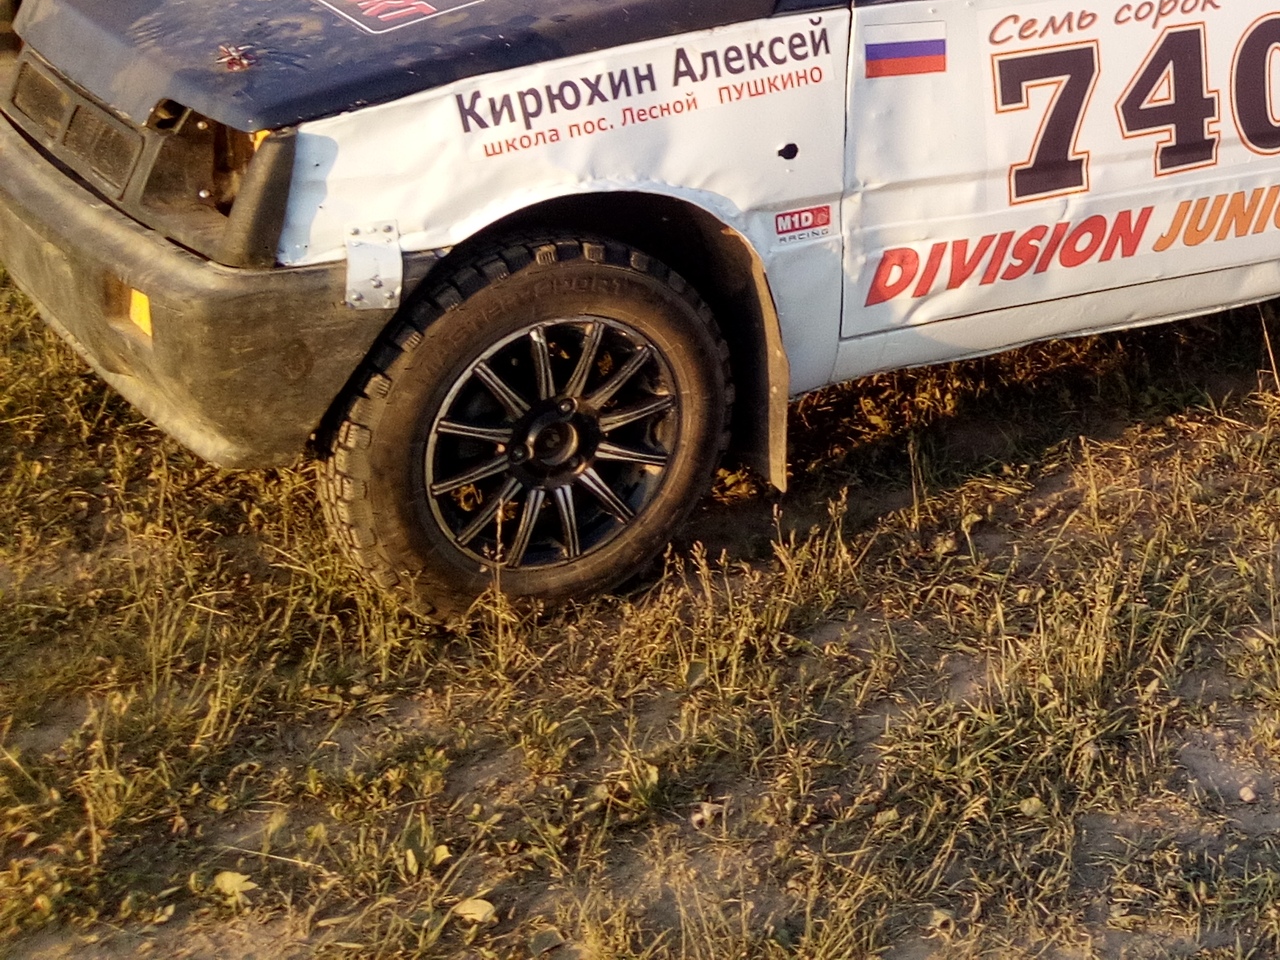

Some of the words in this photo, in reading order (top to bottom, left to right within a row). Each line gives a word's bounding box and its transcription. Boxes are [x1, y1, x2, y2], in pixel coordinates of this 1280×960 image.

[455, 62, 657, 133] Кирюхин
[672, 16, 831, 87] Алексей
[988, 11, 1099, 46] Семь
[483, 126, 561, 158] школа
[568, 117, 614, 140] пос.
[621, 93, 698, 128] Лесной
[717, 65, 824, 105] ПУШКИНО
[779, 228, 829, 243] RACING
[864, 206, 1156, 308] DIVISION
